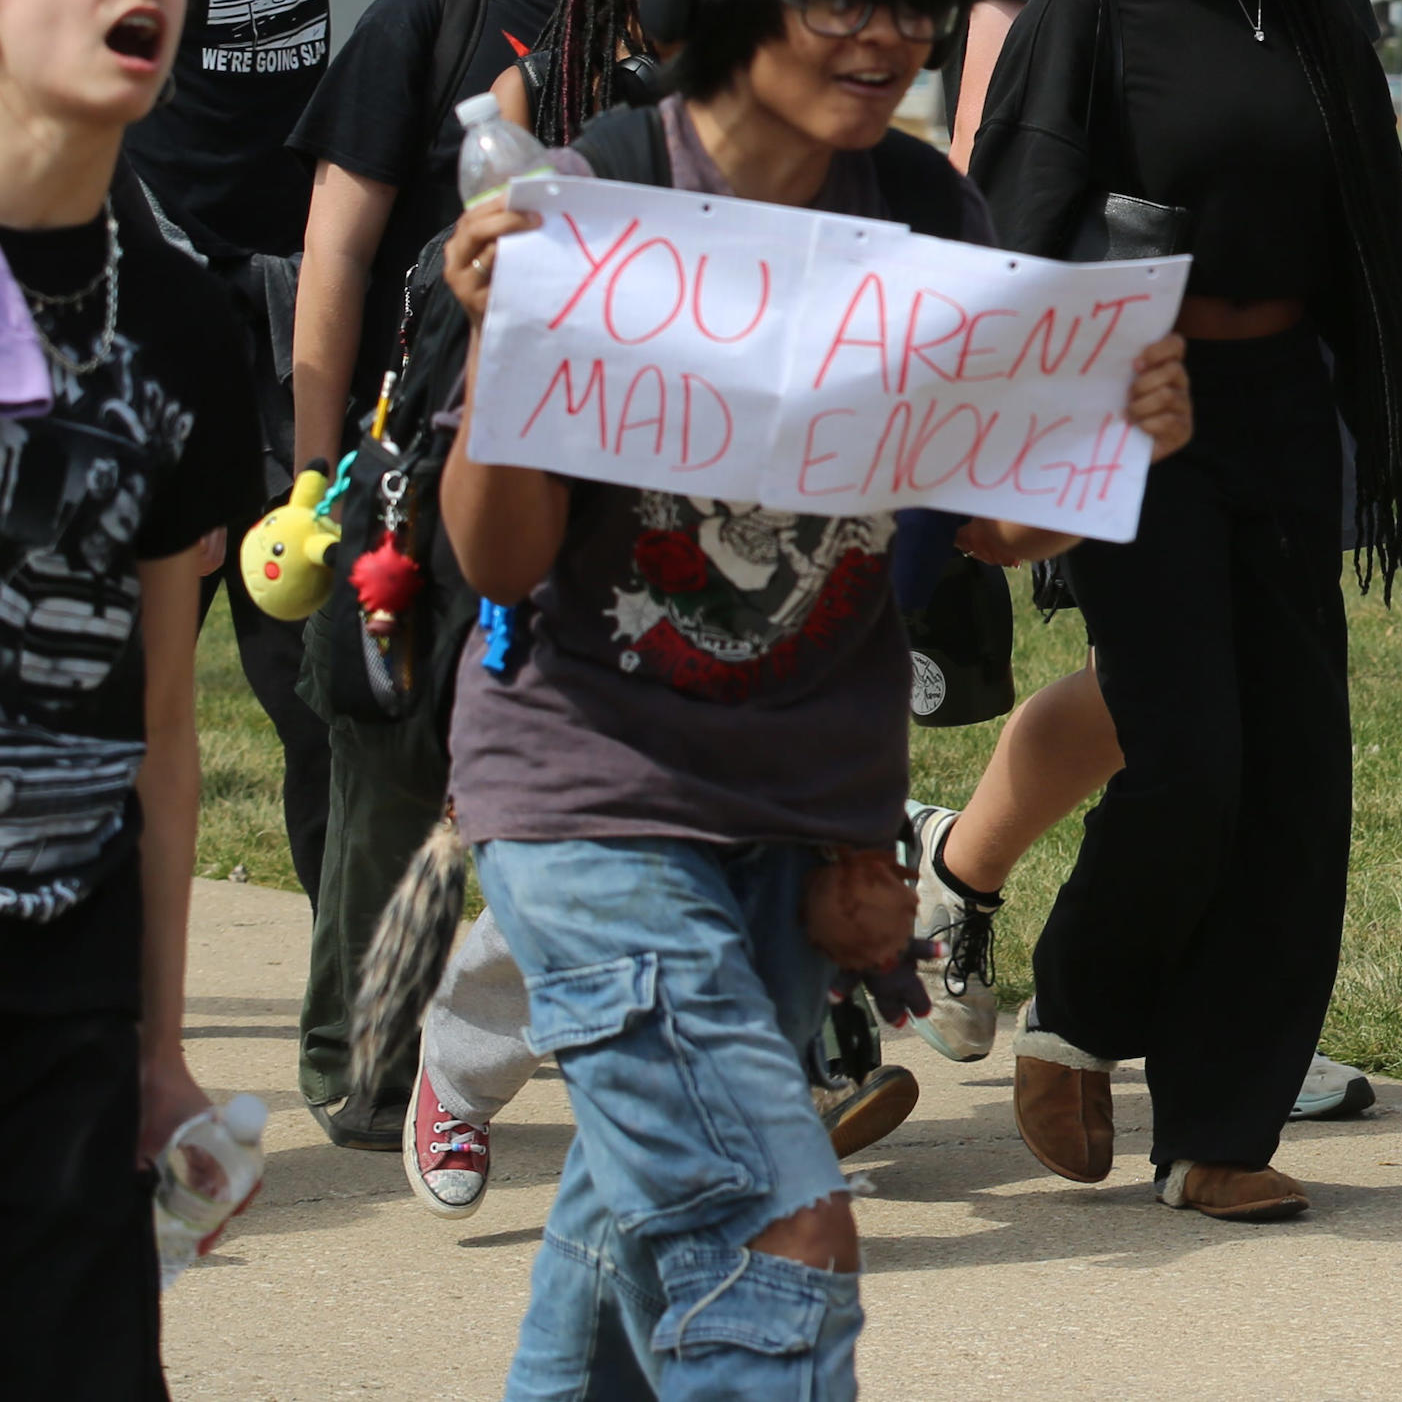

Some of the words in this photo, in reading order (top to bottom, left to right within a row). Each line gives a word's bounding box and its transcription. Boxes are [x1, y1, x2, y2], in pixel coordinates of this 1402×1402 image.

[201, 47, 253, 73] WE'RE
[256, 48, 299, 73] GOING
[547, 211, 771, 346] YOU
[812, 272, 1152, 395] ARENT
[520, 358, 734, 473] MAD
[798, 398, 1132, 511] ENOUGH
